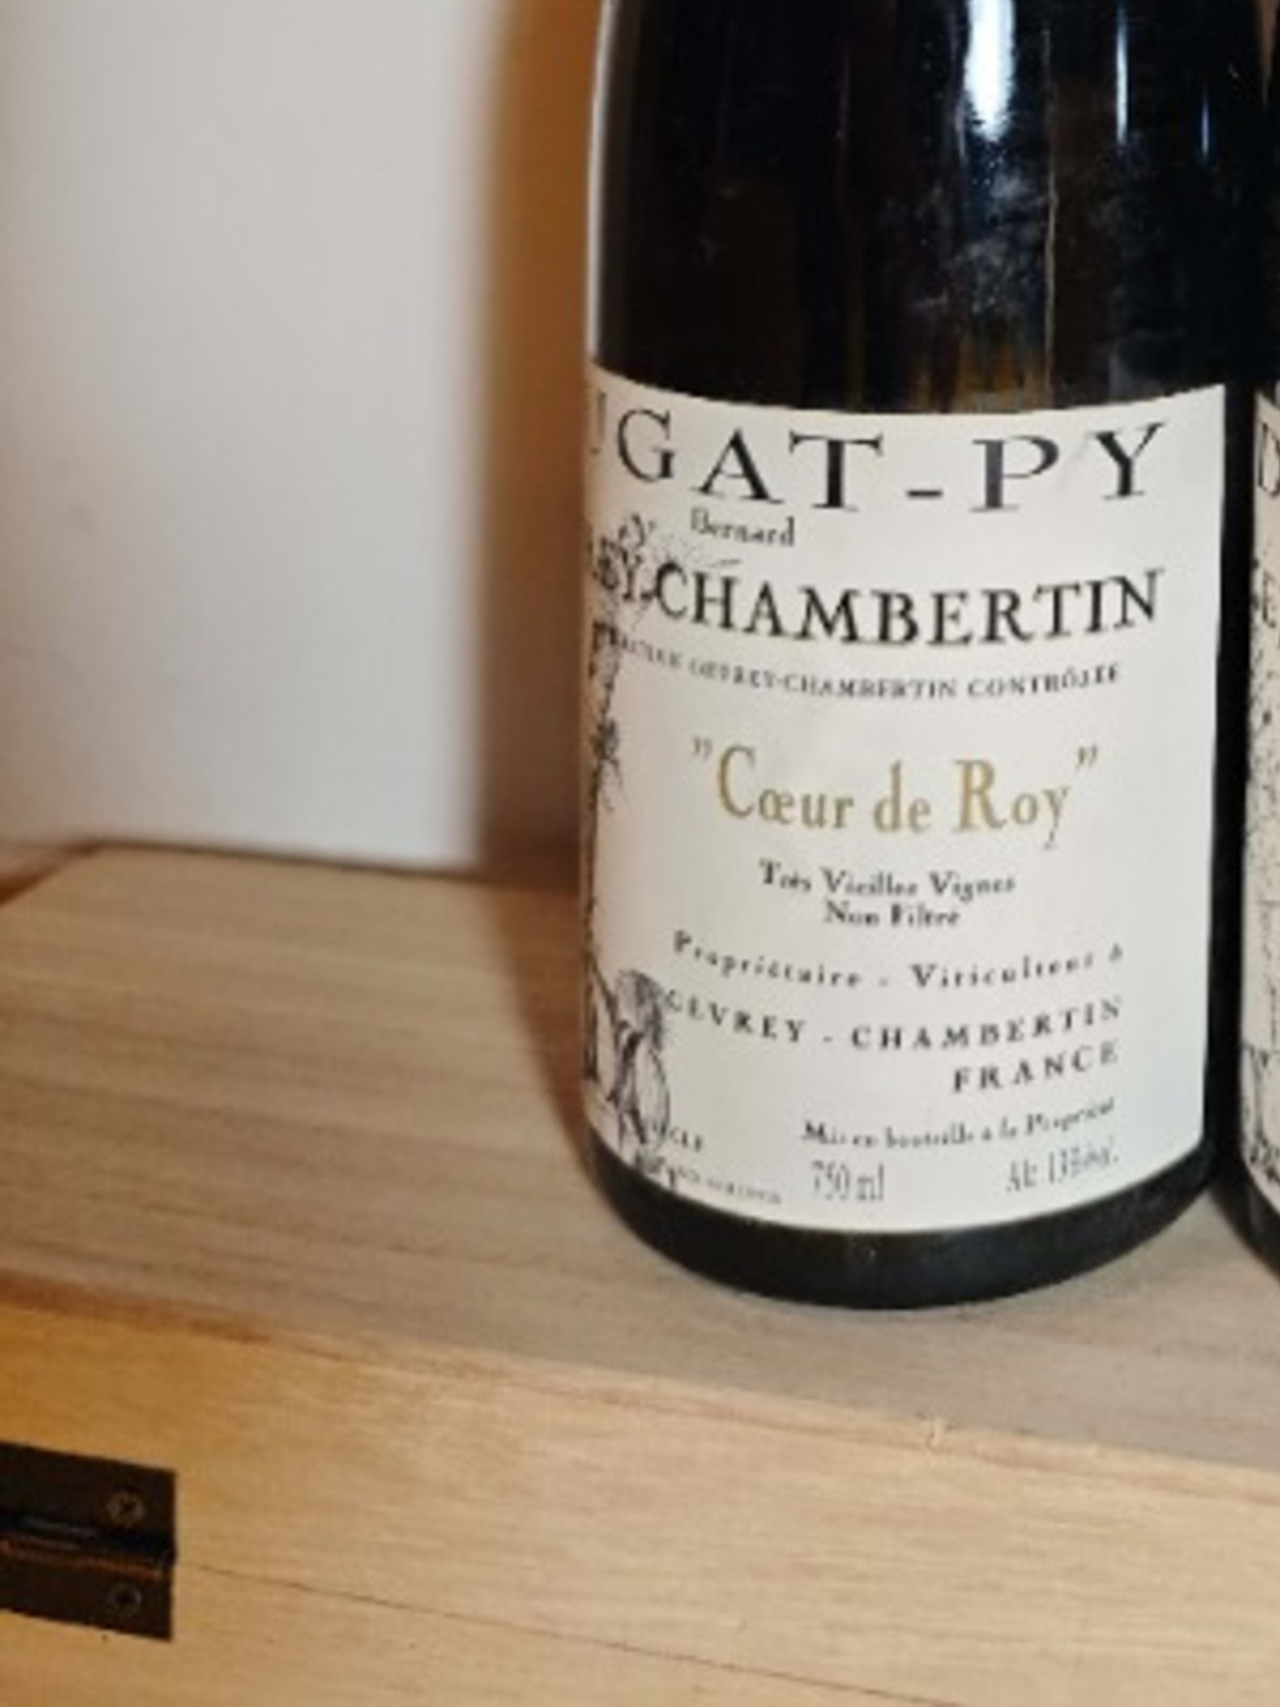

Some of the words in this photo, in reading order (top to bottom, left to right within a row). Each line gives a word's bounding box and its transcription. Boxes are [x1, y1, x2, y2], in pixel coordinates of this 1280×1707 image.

[690, 506, 796, 548] Bernard
[873, 759, 932, 835] de
[822, 867, 918, 896] Vieilles
[928, 870, 1017, 903] Vignes
[823, 899, 880, 928] Non
[673, 929, 863, 989] Propriétaire
[664, 989, 807, 1045] GEVREY
[850, 997, 1122, 1051] CHAMBERTIN
[951, 1040, 1119, 1094] FRANCE
[812, 1159, 851, 1202] 750
